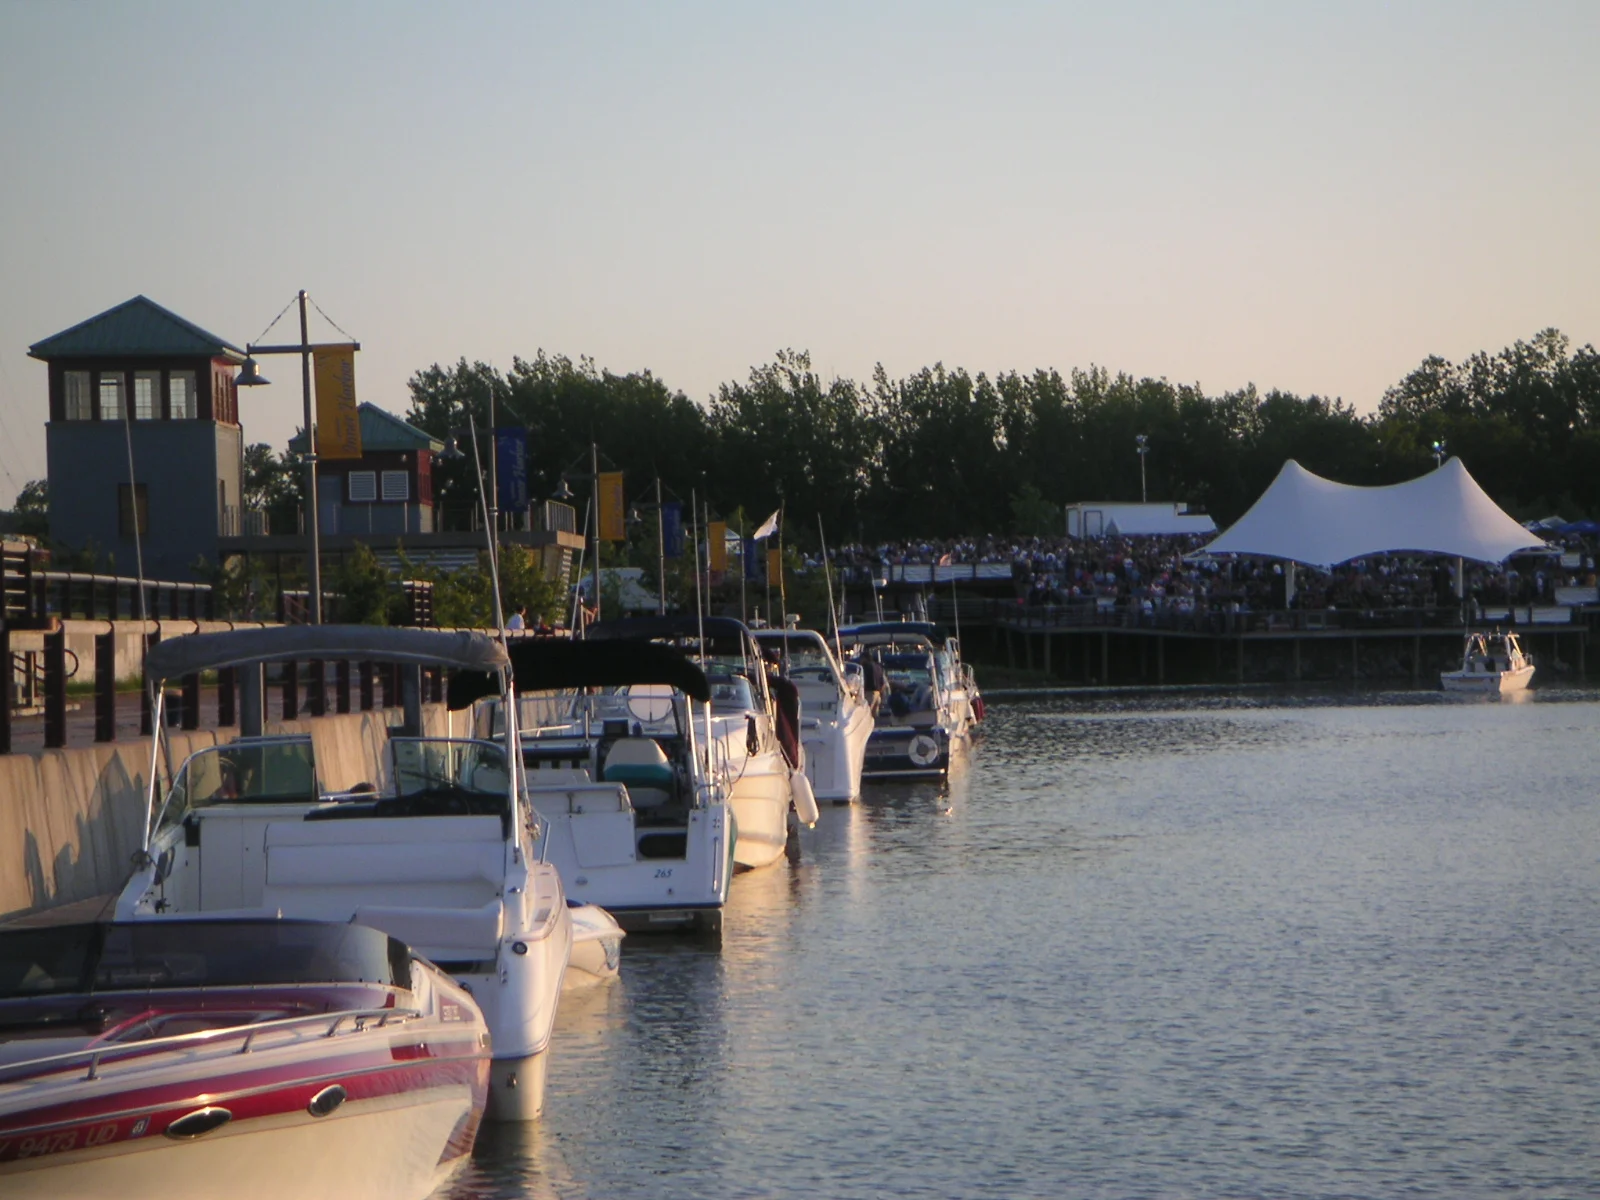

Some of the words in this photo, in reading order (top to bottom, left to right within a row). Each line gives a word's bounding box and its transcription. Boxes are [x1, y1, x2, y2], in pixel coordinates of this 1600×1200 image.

[333, 359, 354, 411] Harbor
[654, 868, 673, 878] 265
[18, 1130, 78, 1158] 9473
[85, 1122, 118, 1147] UD
